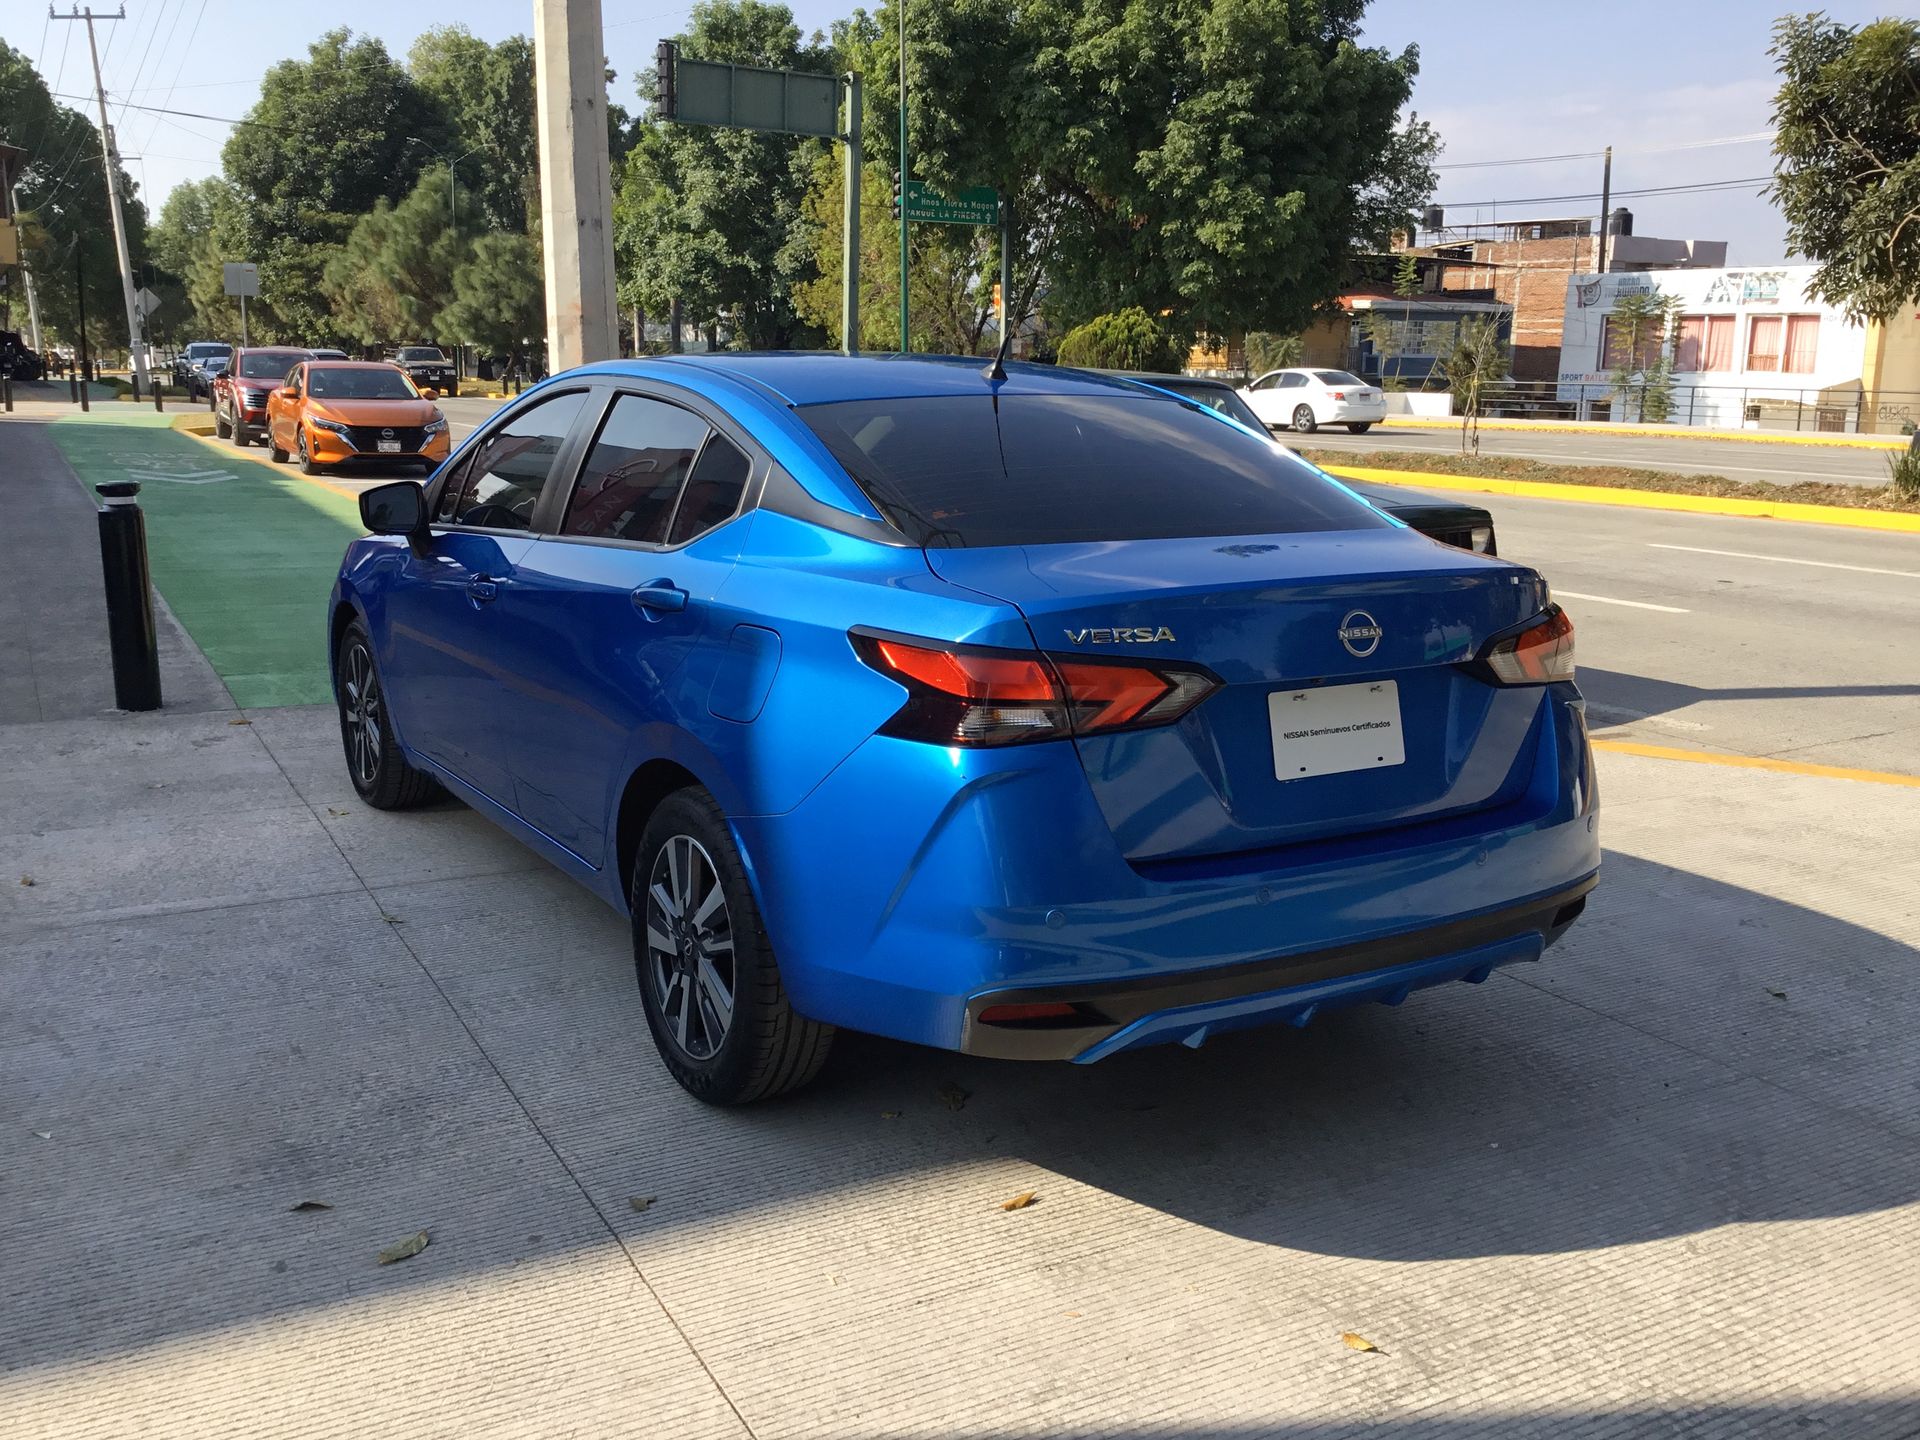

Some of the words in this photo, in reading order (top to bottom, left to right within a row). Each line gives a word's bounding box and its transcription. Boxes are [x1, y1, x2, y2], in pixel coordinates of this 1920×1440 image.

[921, 198, 940, 207] Hnos
[1561, 373, 1584, 381] SPORT
[1064, 626, 1177, 645] VERSA
[1340, 627, 1383, 638] NISSAN
[1283, 730, 1309, 740] NISSAN
[1310, 724, 1351, 737] Seminuevos
[1352, 720, 1391, 732] Certificados
